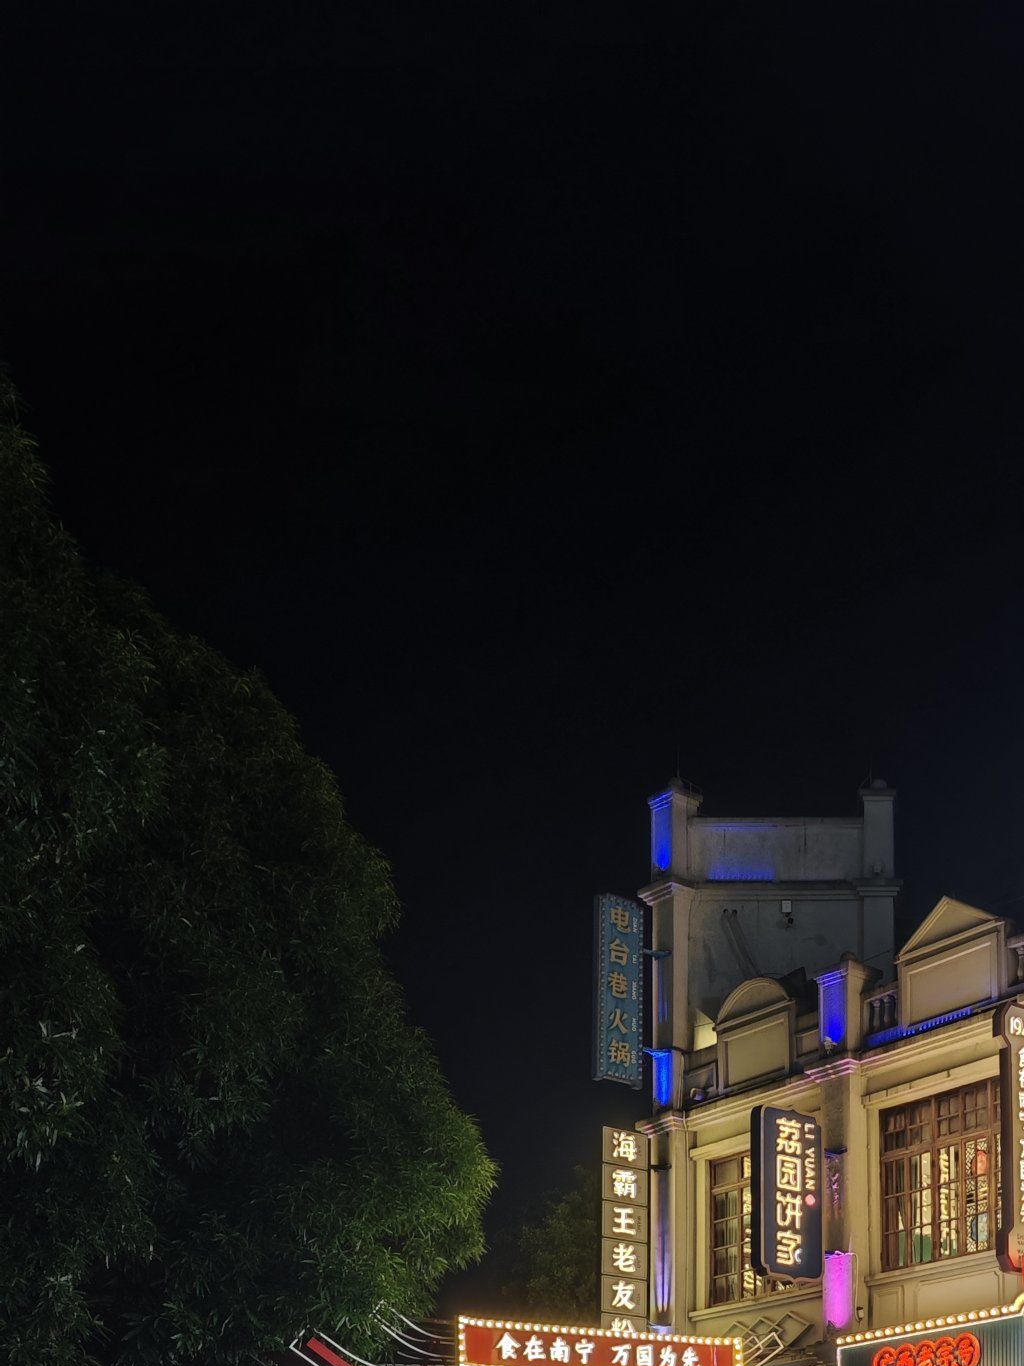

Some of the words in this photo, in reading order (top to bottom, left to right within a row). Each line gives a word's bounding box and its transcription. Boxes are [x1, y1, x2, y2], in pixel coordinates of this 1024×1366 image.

[608, 906, 632, 1068] 电台巷火锅
[804, 1123, 815, 1140] LI
[804, 1147, 816, 1191] YUAN
[495, 1332, 596, 1366] 食在南宁
